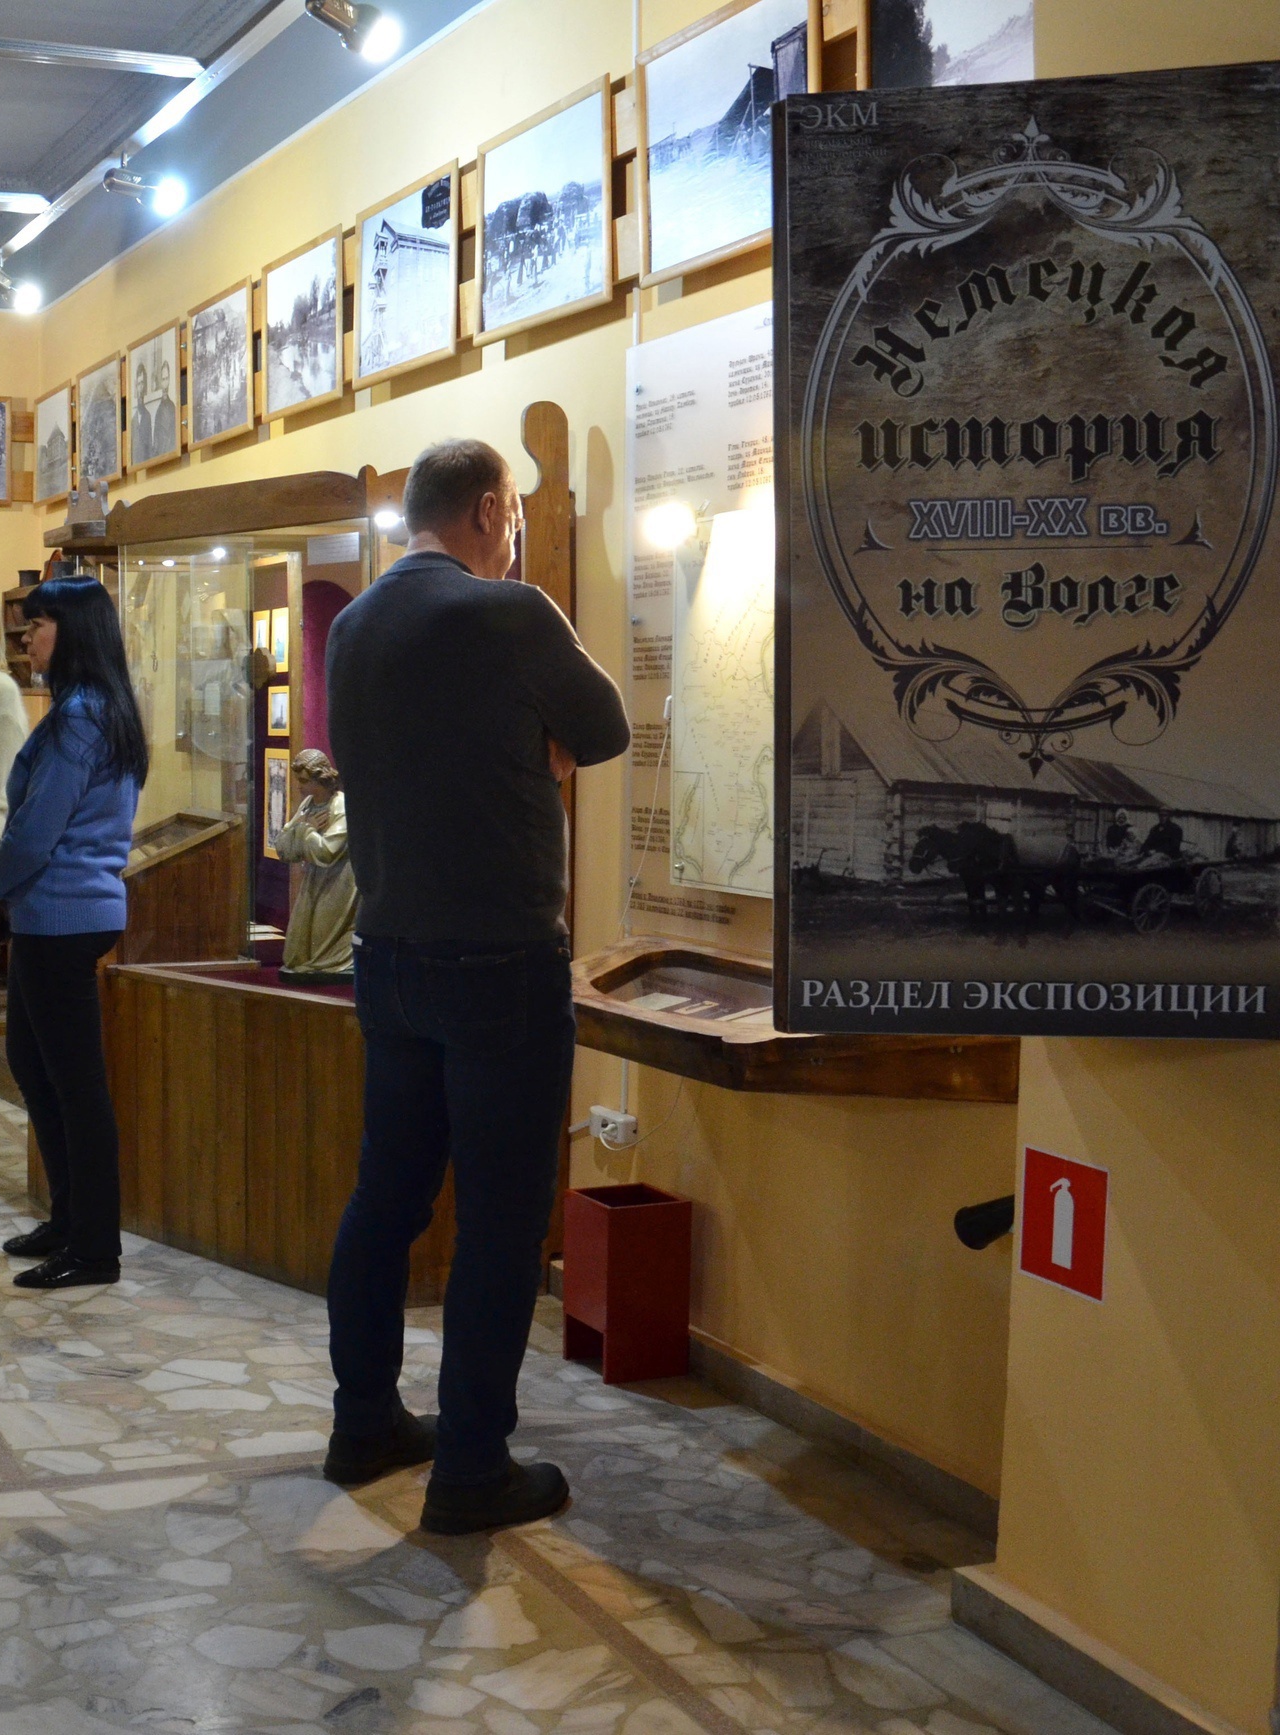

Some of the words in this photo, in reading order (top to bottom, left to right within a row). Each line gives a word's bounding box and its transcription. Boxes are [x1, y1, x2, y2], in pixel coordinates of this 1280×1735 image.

[799, 102, 879, 129] ЭКМ
[850, 257, 1229, 398] Немецкая
[853, 408, 1223, 483] история
[908, 498, 1088, 539] XVIII-XX
[897, 576, 977, 617] на
[1001, 562, 1183, 628] Волге
[800, 979, 951, 1016] РАЗДЕЛ
[962, 981, 1267, 1020] ЭКСПОЗИЦИИ
